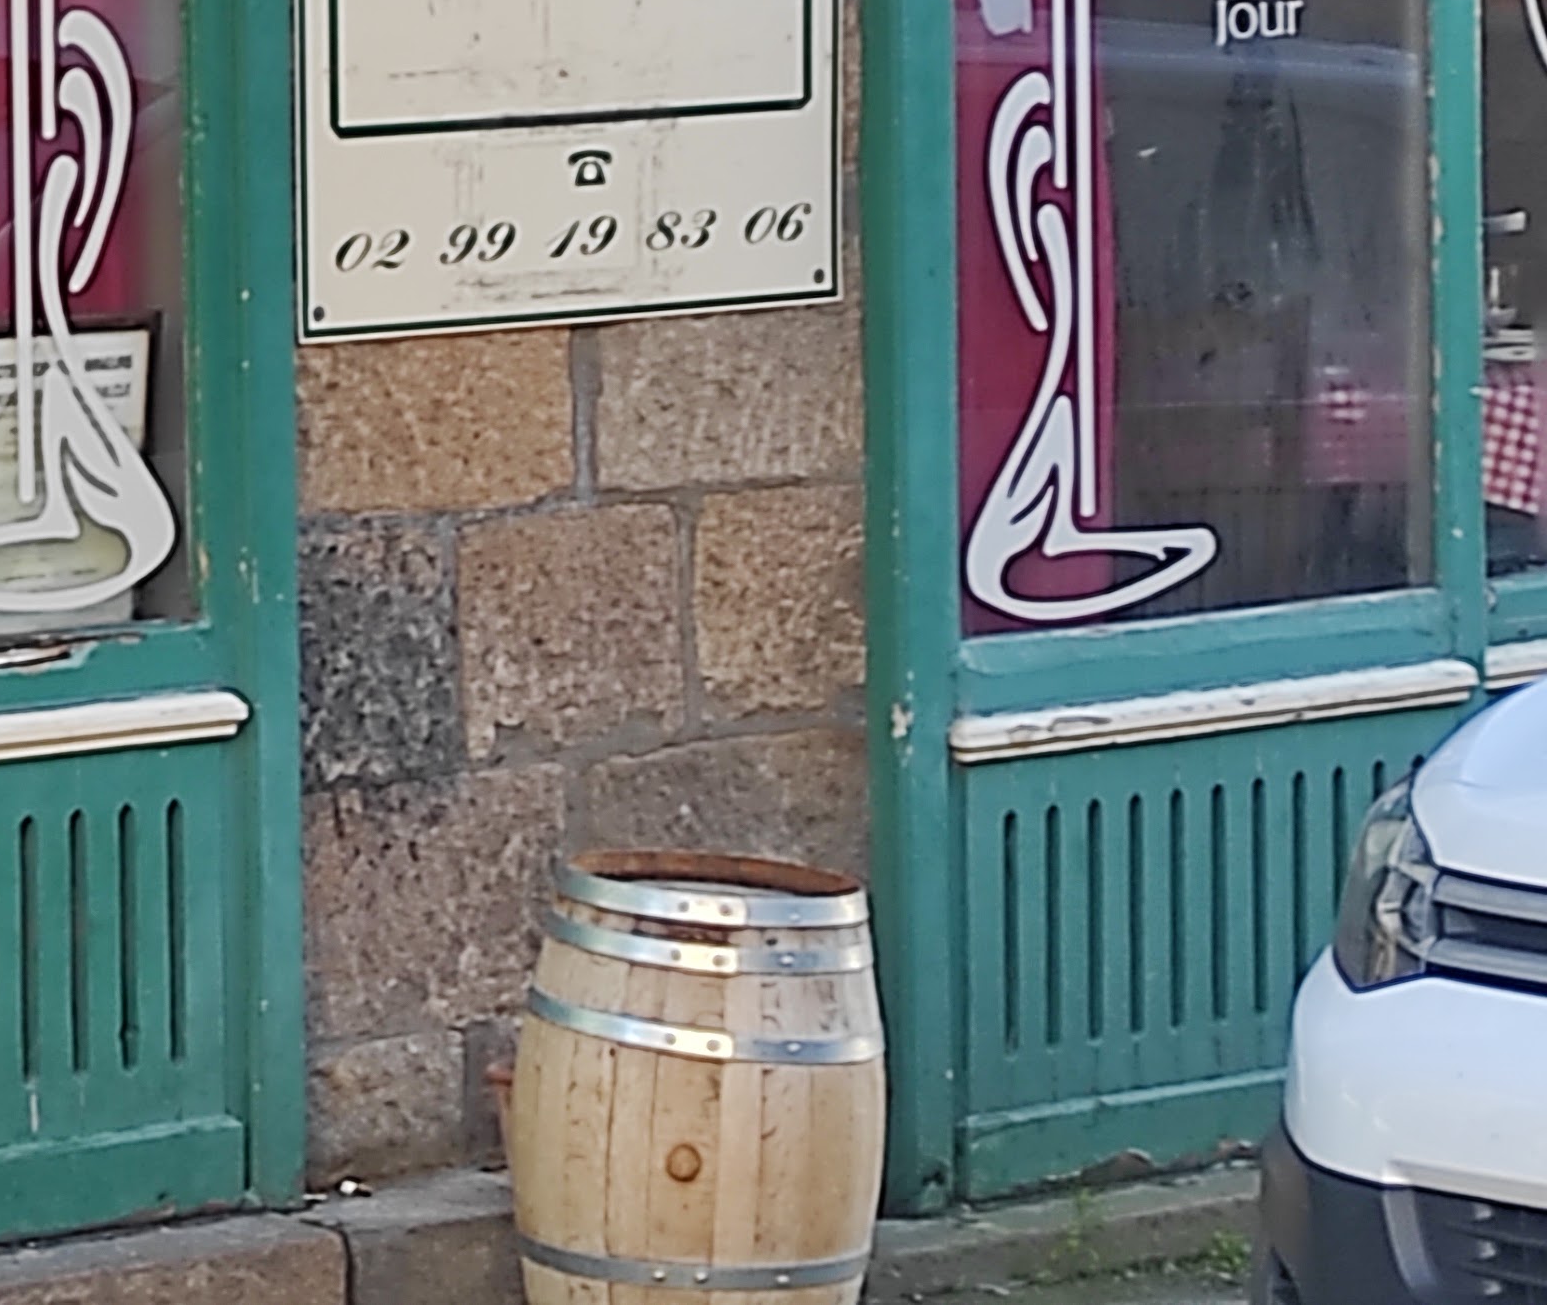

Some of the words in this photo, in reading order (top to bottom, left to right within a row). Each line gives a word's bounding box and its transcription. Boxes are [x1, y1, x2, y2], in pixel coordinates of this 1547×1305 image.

[335, 228, 410, 272] 02
[439, 222, 516, 264] 99
[549, 215, 617, 258] 19
[646, 208, 717, 250] 83
[745, 202, 811, 244] 06
